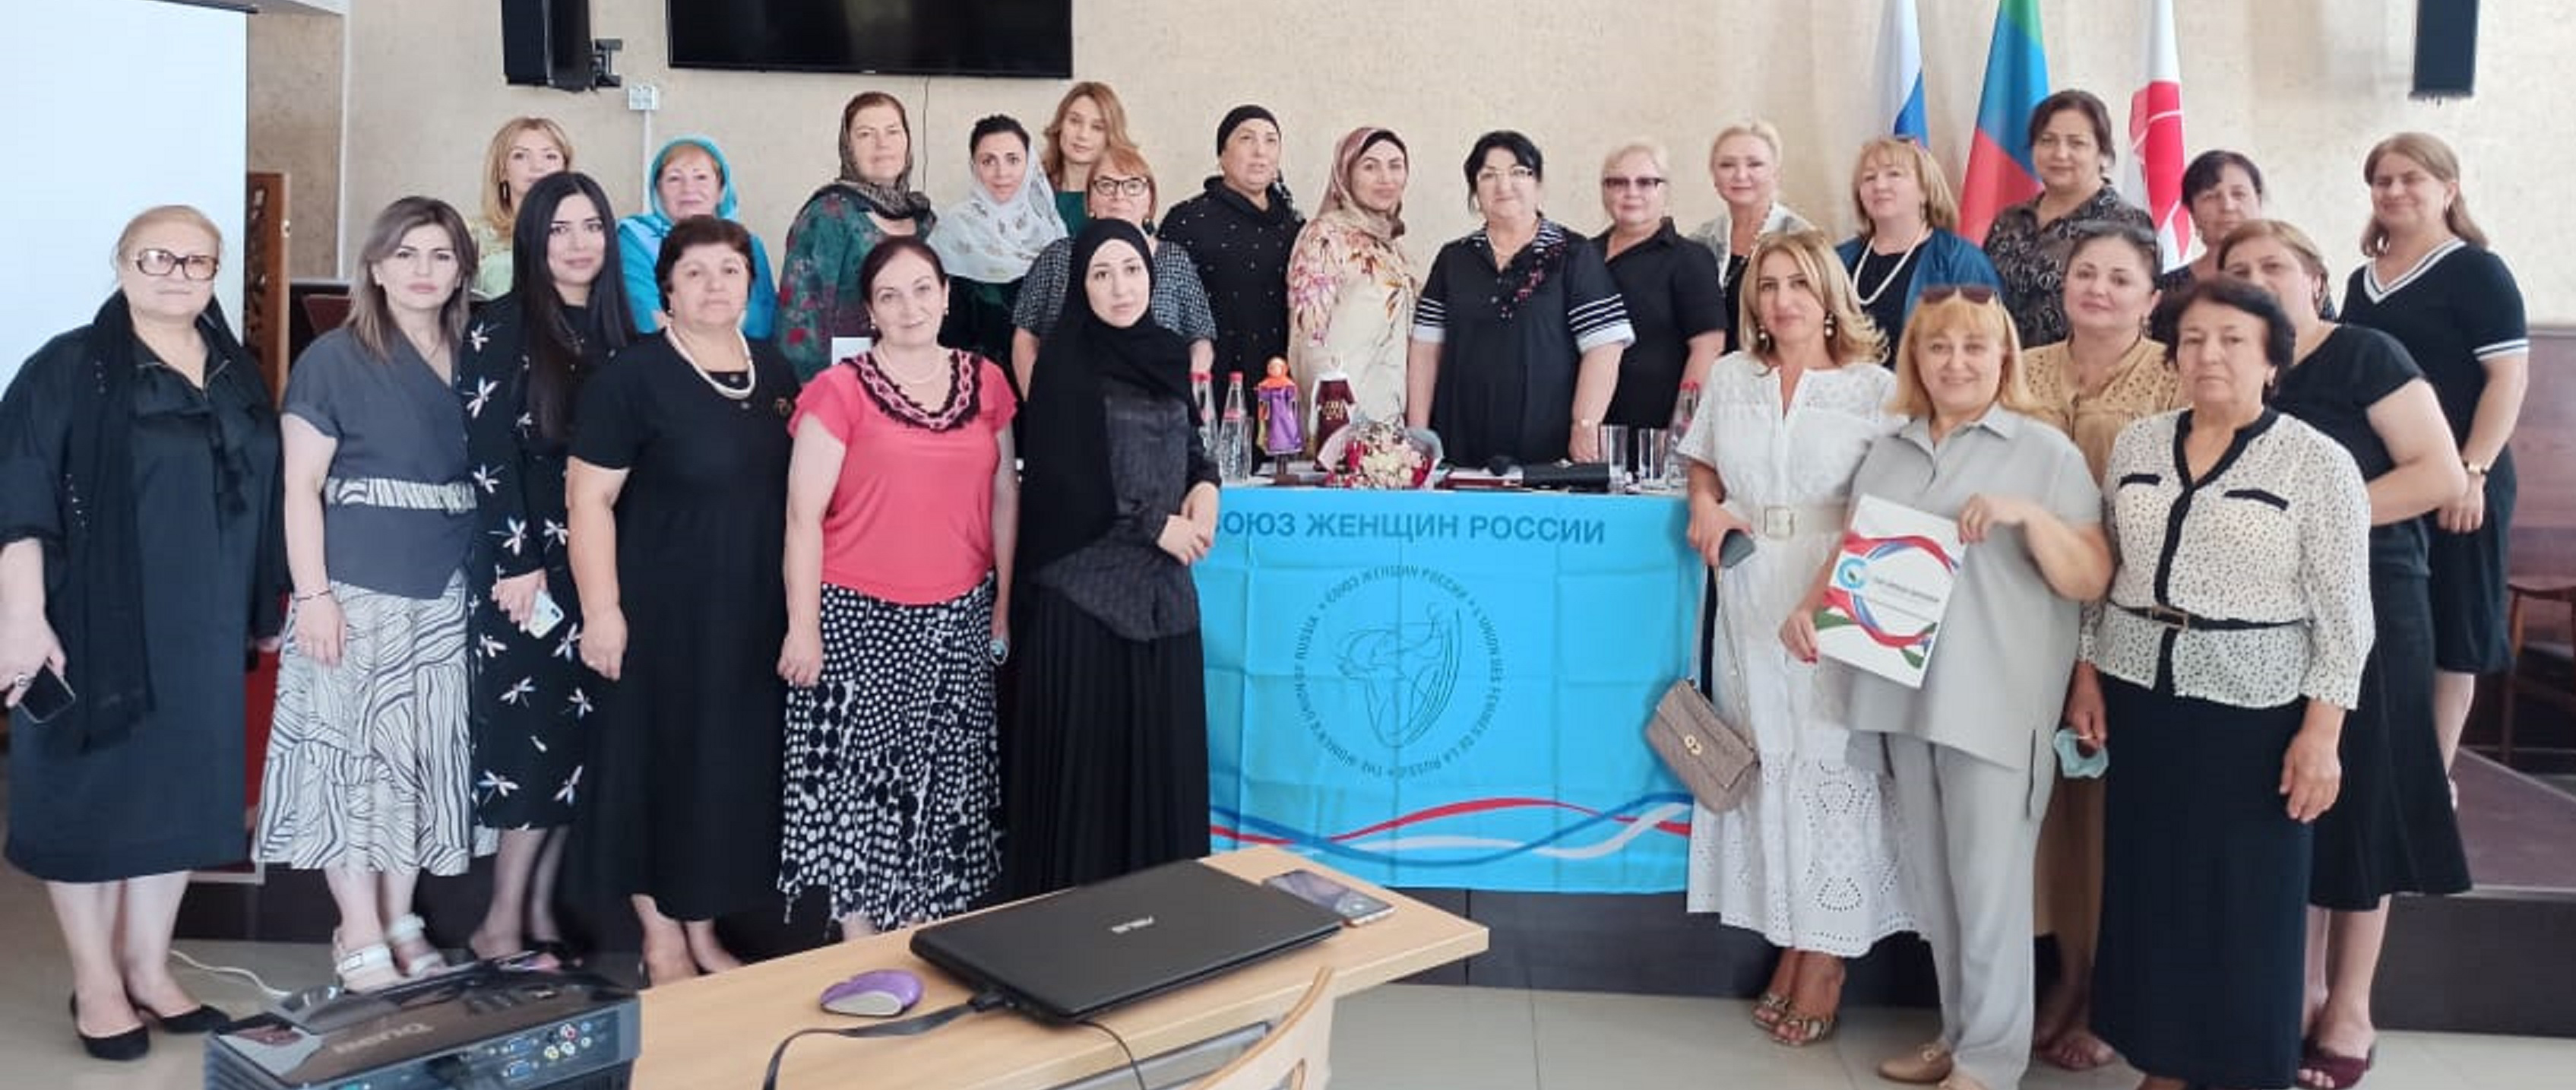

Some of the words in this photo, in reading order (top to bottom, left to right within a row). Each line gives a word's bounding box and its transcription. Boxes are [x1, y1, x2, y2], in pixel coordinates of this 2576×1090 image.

[1216, 510, 1295, 537] ОЮЗ
[1305, 511, 1459, 543] ЖЕНЩИН
[1469, 515, 1605, 545] РОССИИ
